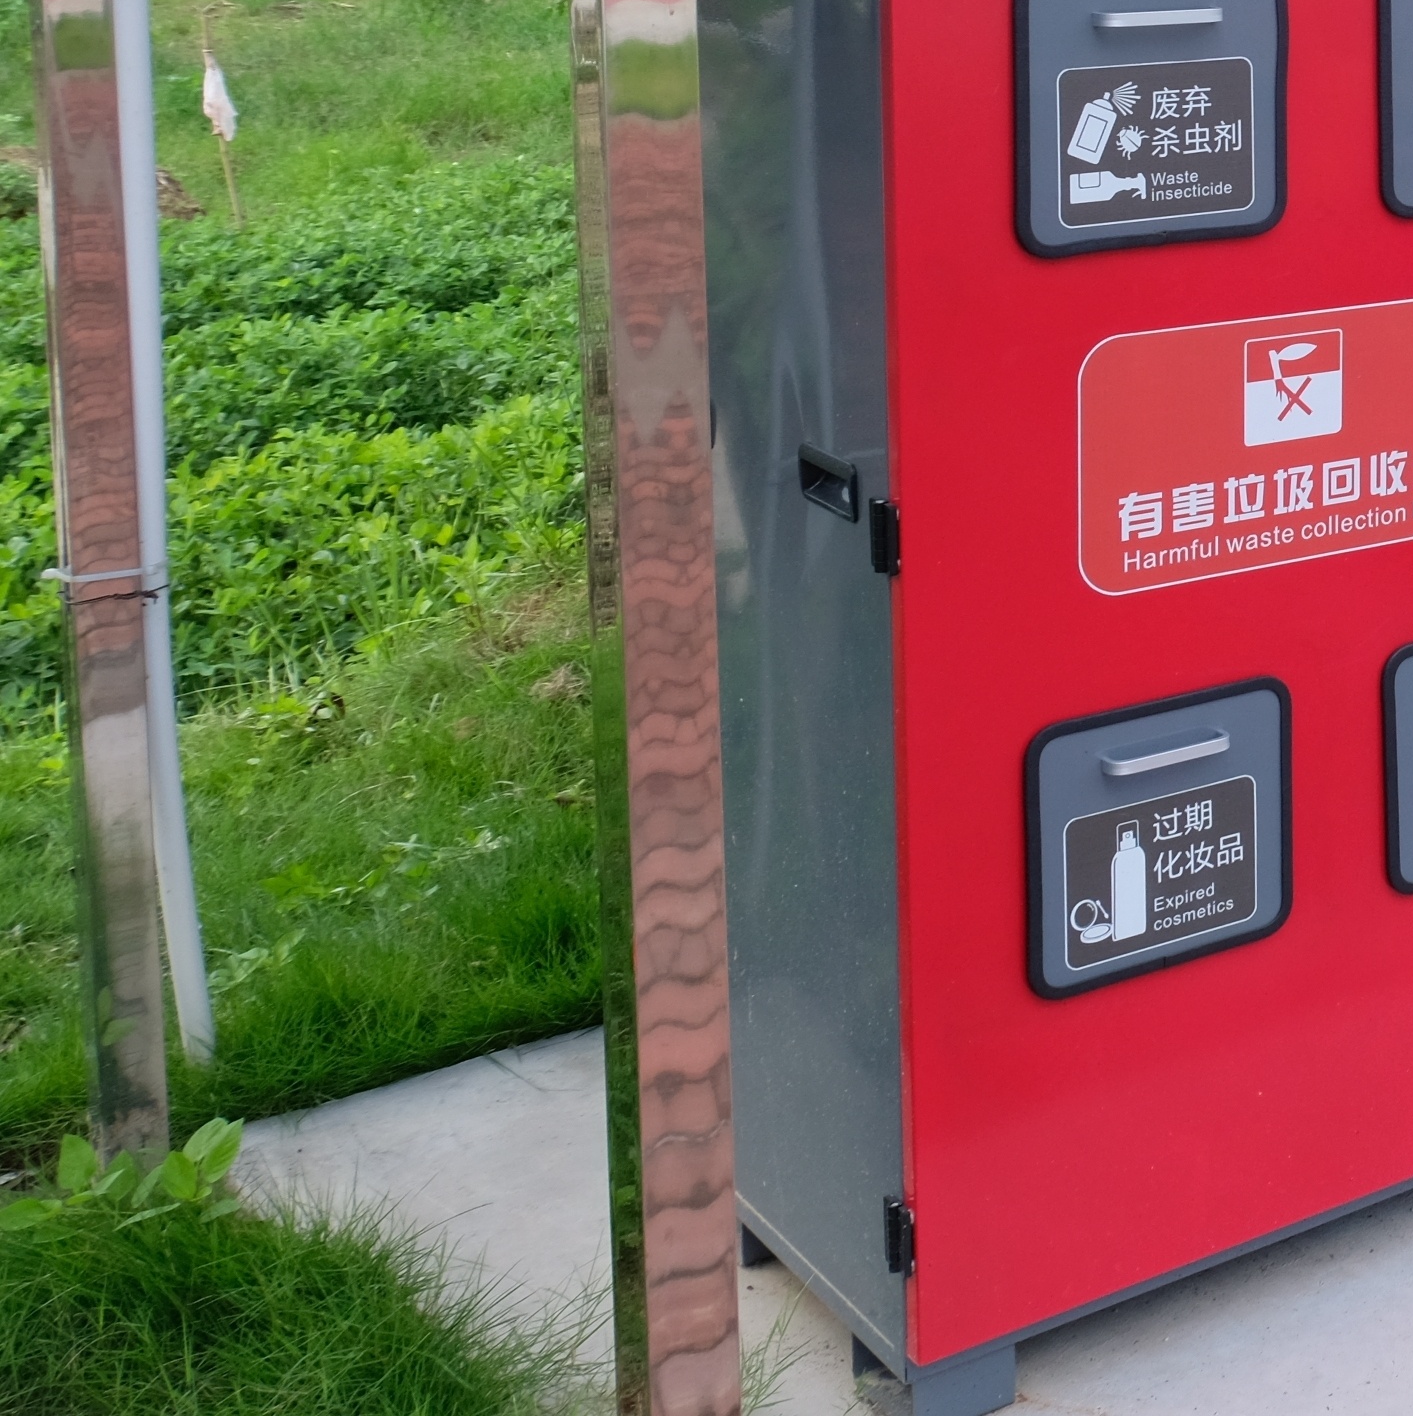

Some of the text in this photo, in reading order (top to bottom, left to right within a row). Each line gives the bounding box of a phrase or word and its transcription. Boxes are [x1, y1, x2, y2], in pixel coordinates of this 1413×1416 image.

[1150, 85, 1212, 120] 废弃
[1151, 120, 1243, 158] 杀虫剂
[1151, 170, 1199, 186] Waste
[1151, 181, 1233, 202] insecticide
[1122, 535, 1221, 574] Harmful
[1226, 525, 1295, 553] waste
[1300, 501, 1408, 542] collection
[1152, 800, 1214, 843] 过期
[1152, 832, 1245, 883] 化妆品
[1153, 881, 1216, 913] Expired
[1153, 895, 1235, 931] cosmetics
